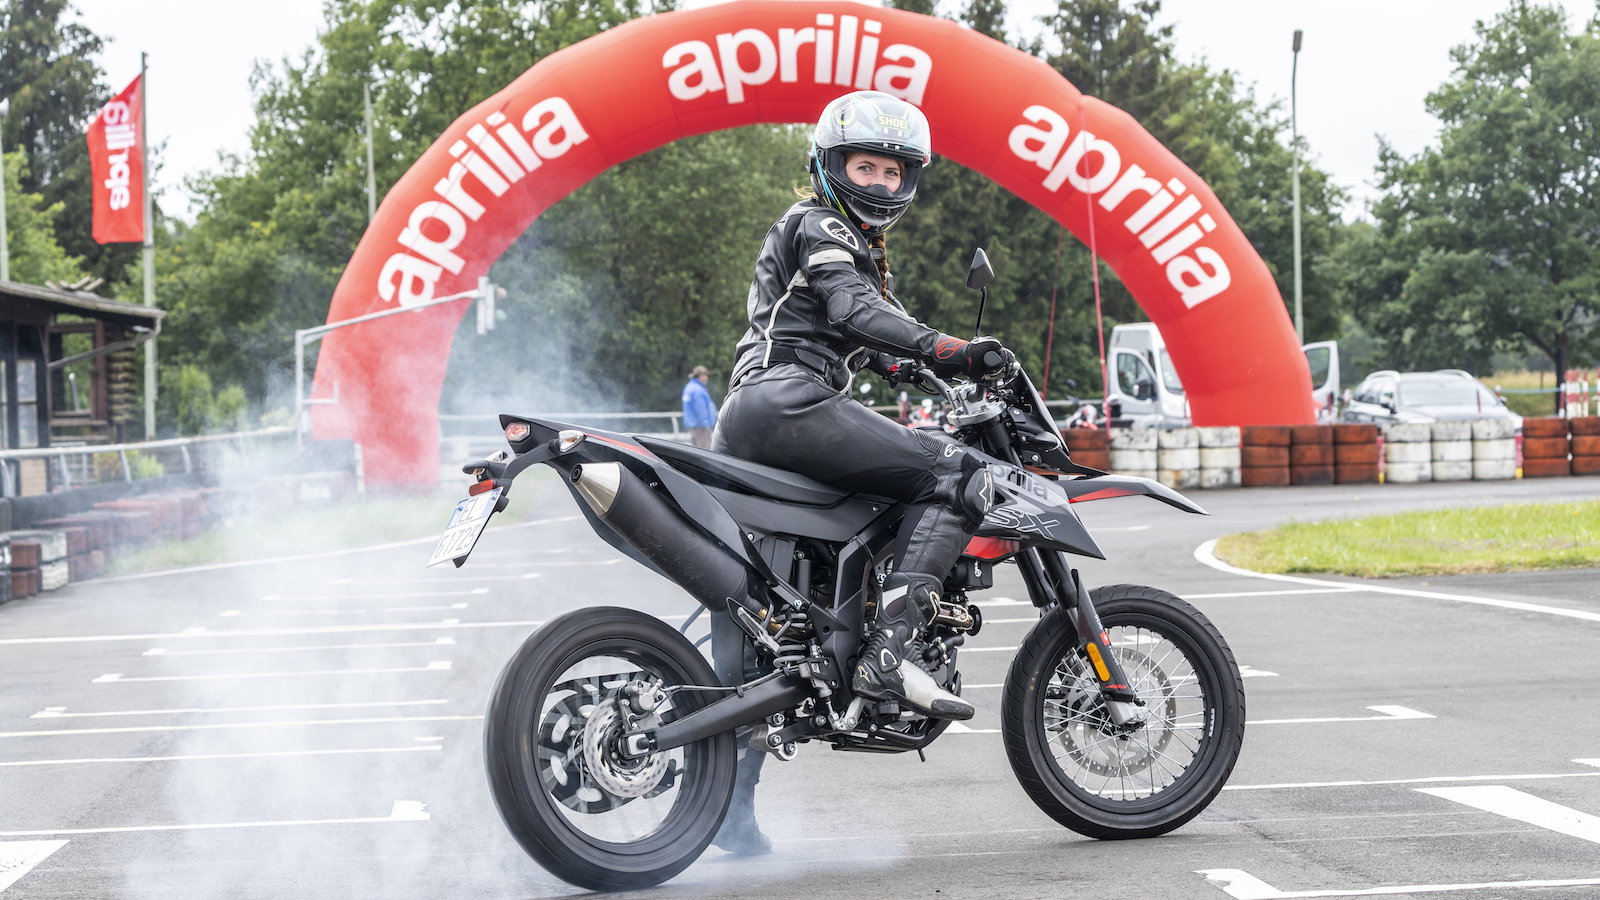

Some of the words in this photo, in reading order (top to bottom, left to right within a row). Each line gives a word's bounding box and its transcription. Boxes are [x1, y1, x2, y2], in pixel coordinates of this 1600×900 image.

[662, 13, 933, 106] aprilia
[878, 115, 909, 130] SHOEI
[377, 96, 590, 312] aprilia
[1008, 104, 1231, 310] aprilia
[988, 464, 1048, 500] prilia
[983, 506, 1061, 541] SX
